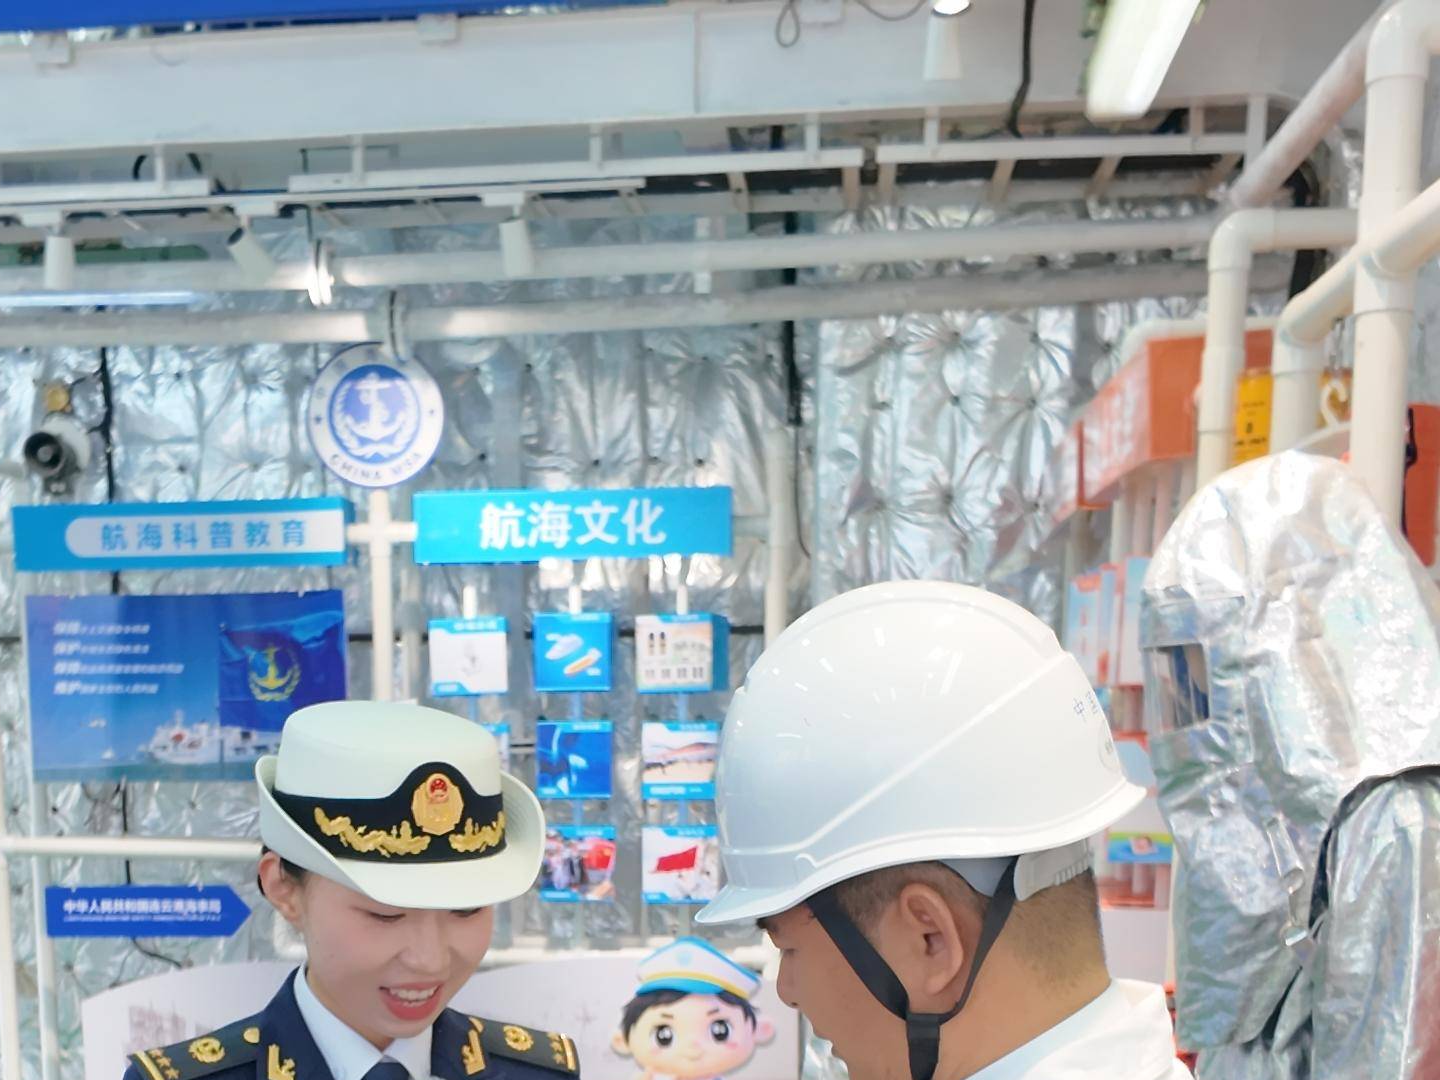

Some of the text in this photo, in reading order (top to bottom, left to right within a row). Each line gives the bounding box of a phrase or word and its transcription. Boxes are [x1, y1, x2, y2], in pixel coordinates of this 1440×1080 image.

[100, 519, 305, 551] 航海科普教育
[479, 497, 667, 550] 航海文化
